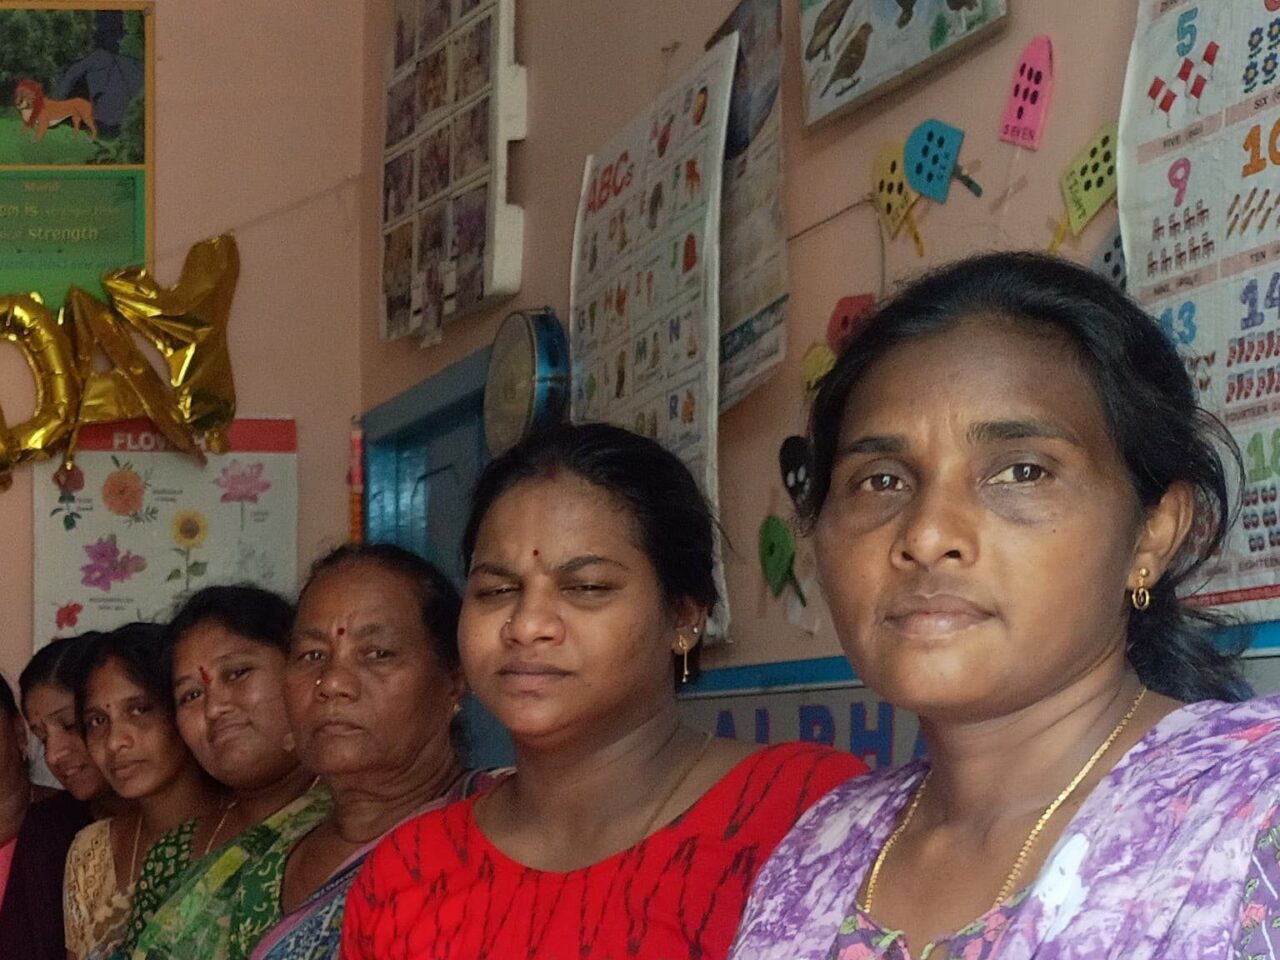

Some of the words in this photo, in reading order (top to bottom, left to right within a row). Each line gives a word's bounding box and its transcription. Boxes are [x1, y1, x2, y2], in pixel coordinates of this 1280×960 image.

[1176, 7, 1198, 57] 5
[1168, 157, 1191, 207] 9
[25, 202, 39, 217] is
[28, 226, 99, 242] strength
